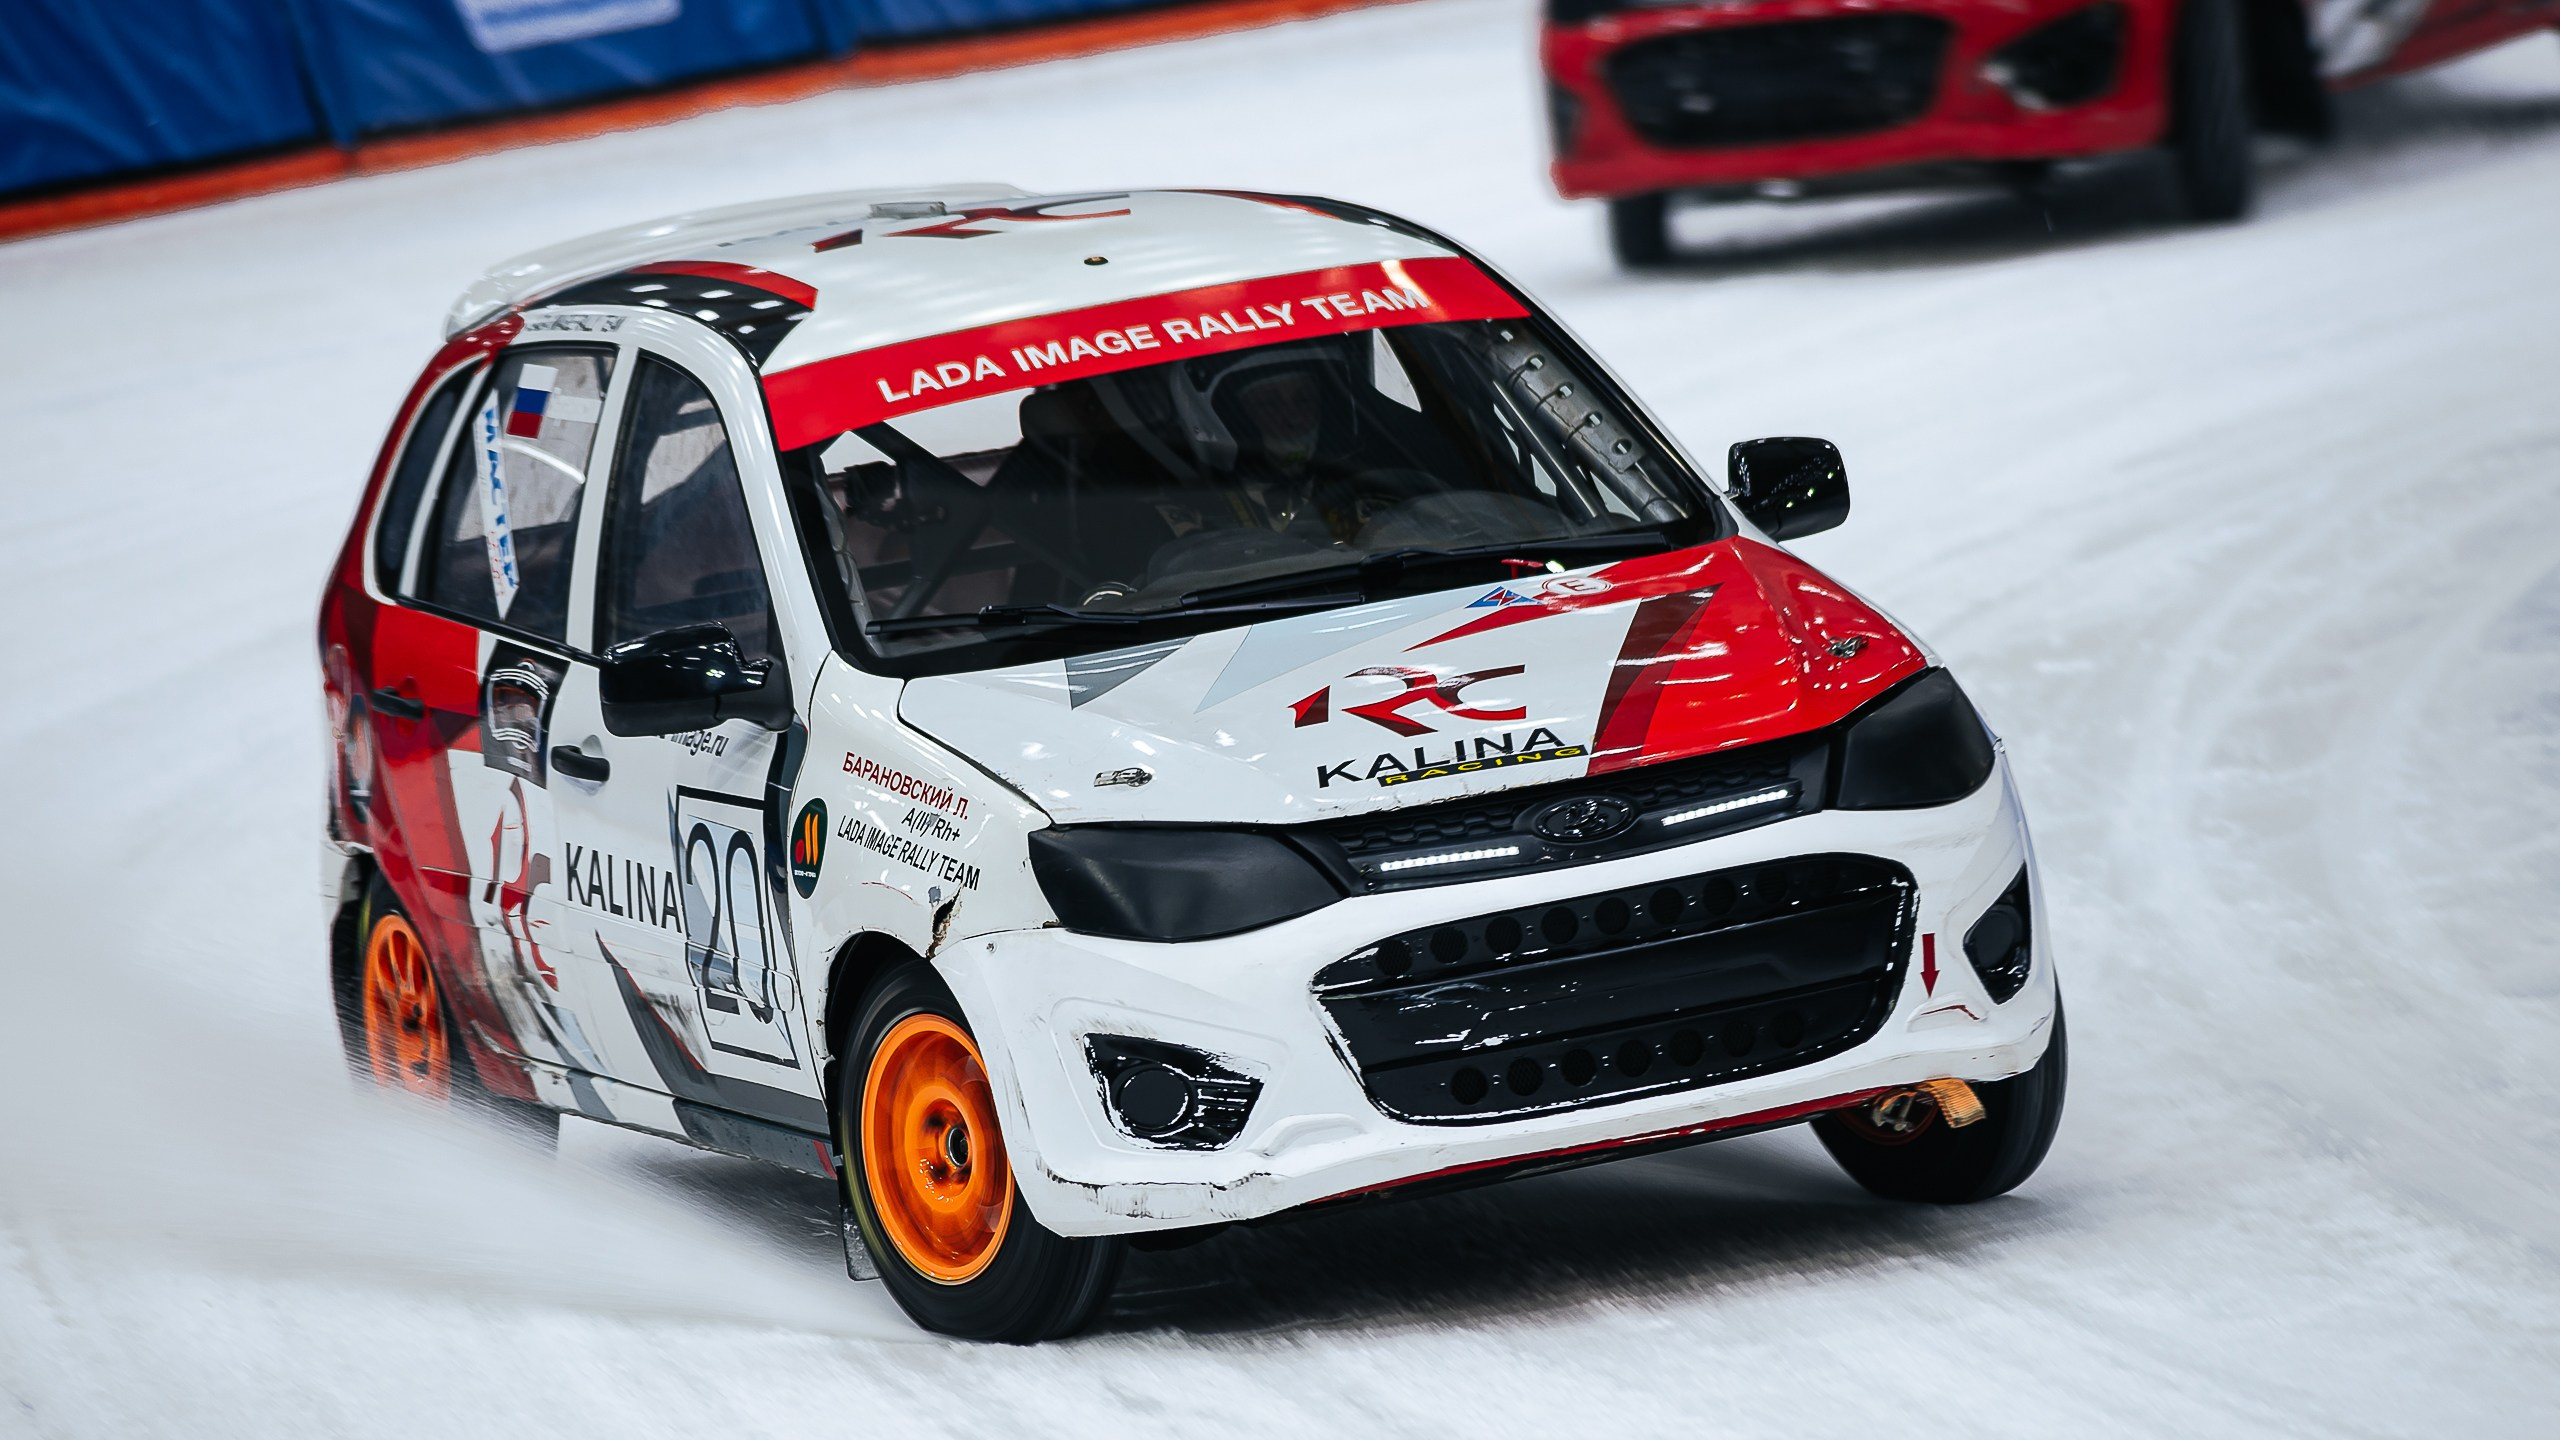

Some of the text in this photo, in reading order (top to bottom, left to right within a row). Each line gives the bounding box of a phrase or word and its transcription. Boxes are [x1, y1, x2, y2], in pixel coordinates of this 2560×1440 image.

[877, 287, 1430, 402] LADA IMAGE RALLY TEAM
[843, 752, 953, 812] БАРАНОВСКИЙ
[1317, 727, 1566, 788] KALINA
[1385, 747, 1582, 784] RACING
[838, 815, 981, 890] LADA IMAGE RALLY TEAM
[931, 818, 961, 841] Rh+
[566, 842, 682, 934] KALINA
[686, 822, 774, 1025] 20
